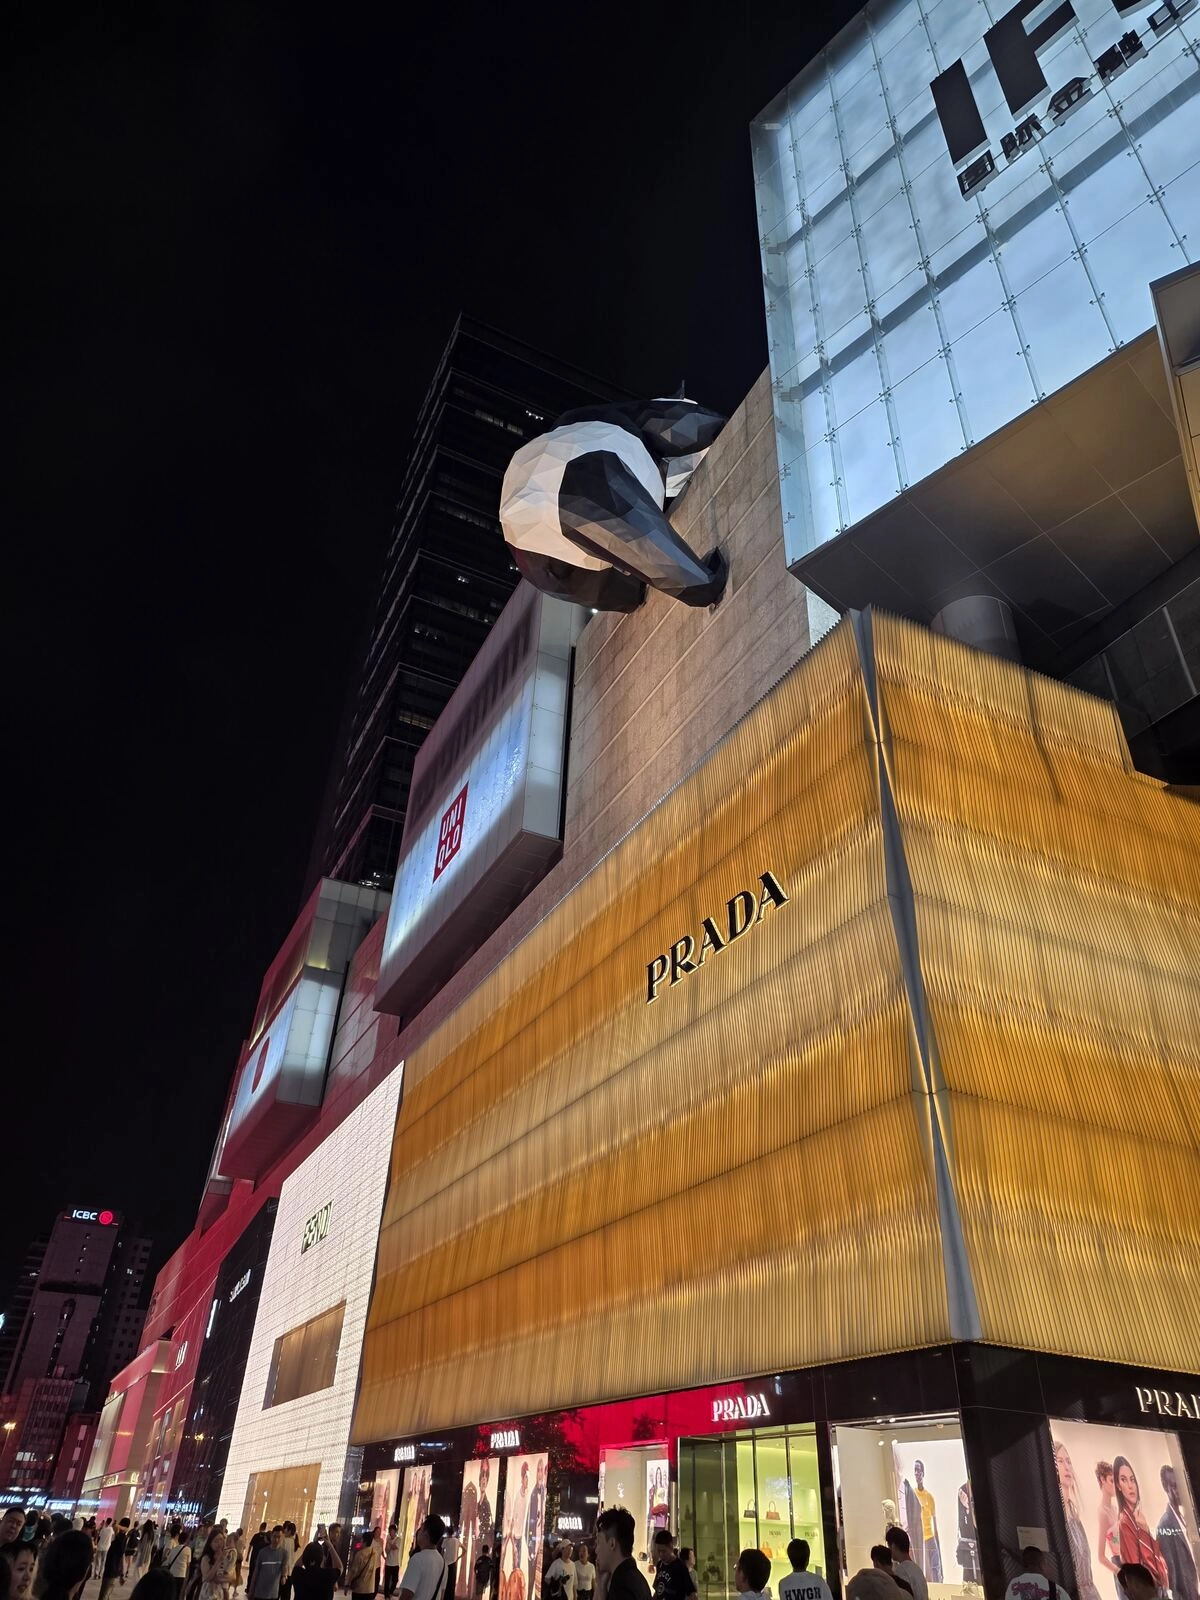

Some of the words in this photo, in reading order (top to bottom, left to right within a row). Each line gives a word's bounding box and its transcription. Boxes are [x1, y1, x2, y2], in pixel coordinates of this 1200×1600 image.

[930, 0, 1143, 166] IF
[442, 797, 462, 841] UNI
[438, 824, 460, 870] QLO
[646, 871, 790, 1004] PRADA
[72, 1209, 98, 1220] ICBC
[711, 1393, 771, 1422] PRADA
